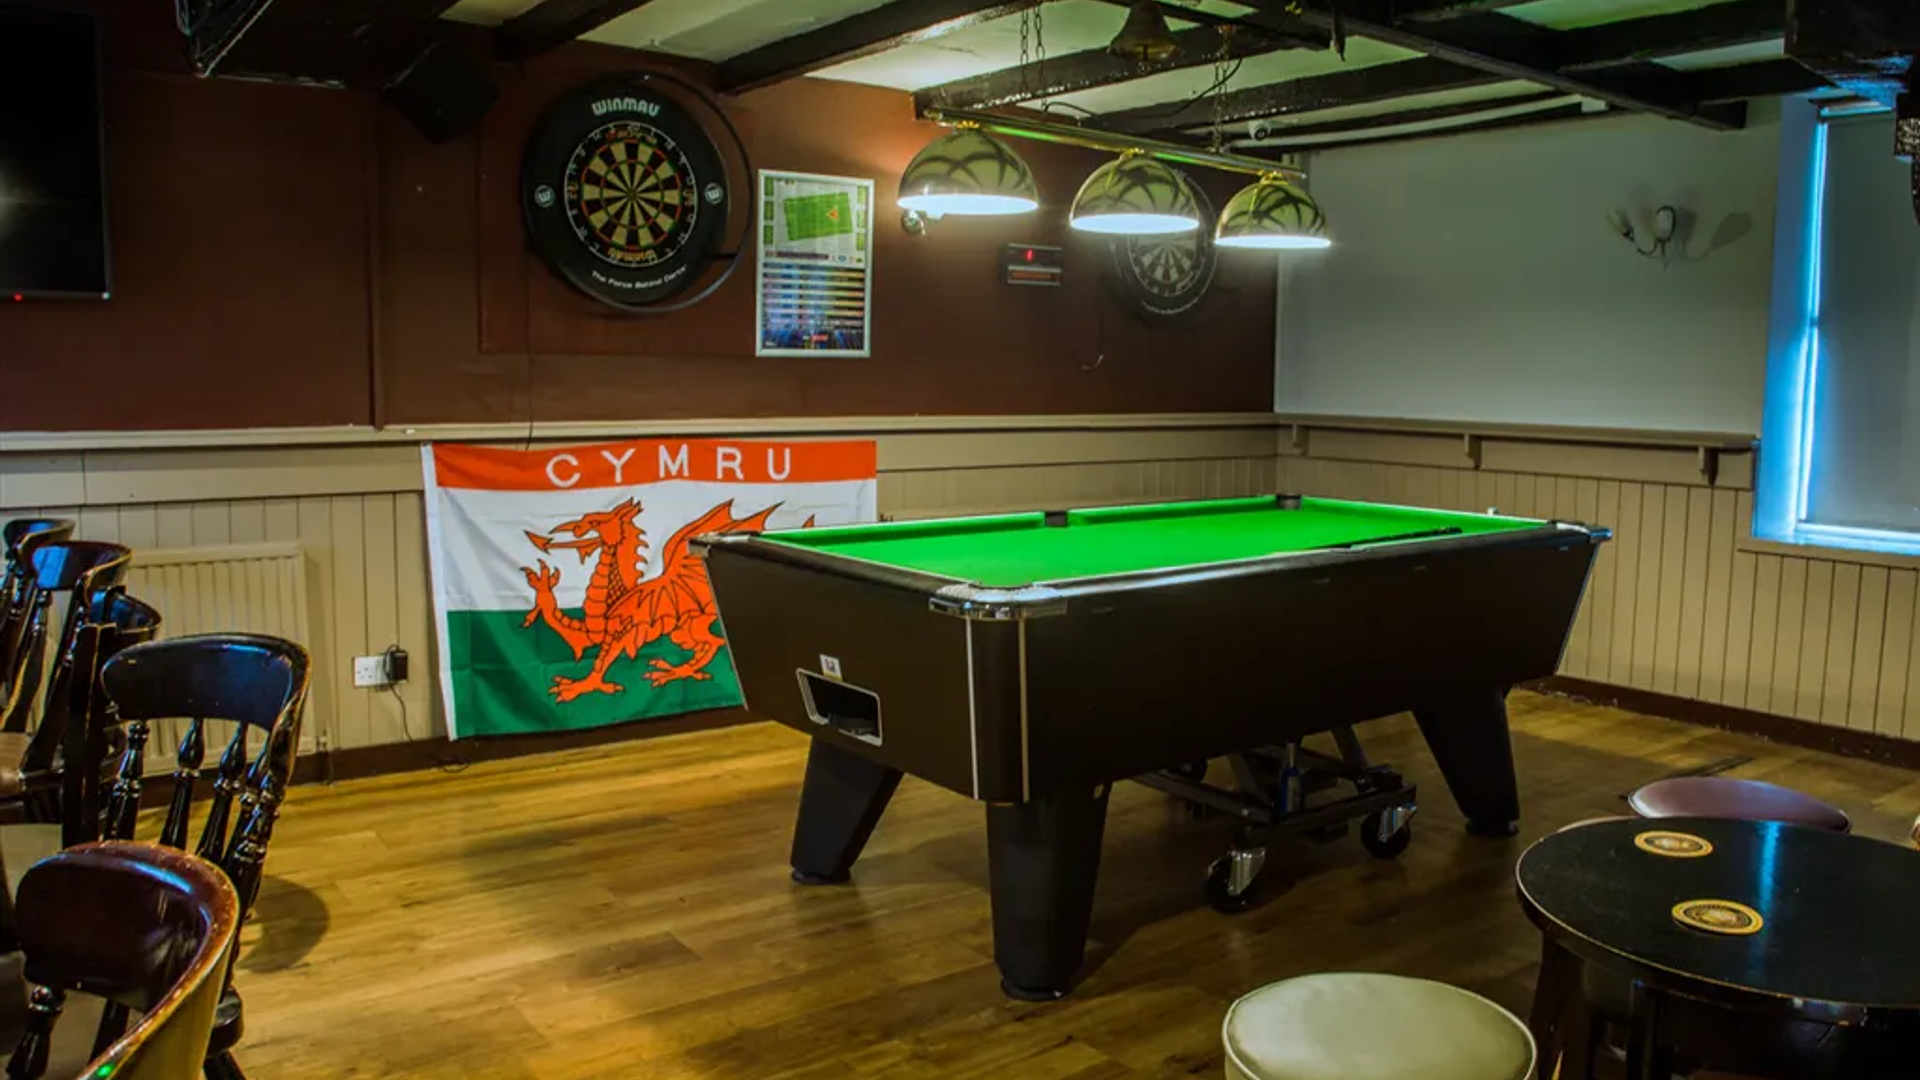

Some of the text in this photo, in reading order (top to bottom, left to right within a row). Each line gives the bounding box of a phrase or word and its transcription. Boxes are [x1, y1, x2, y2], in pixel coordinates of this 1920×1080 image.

[591, 97, 661, 116] WINMAU
[592, 265, 687, 289] The Force Behind Darts
[546, 444, 791, 488] CYMRU
